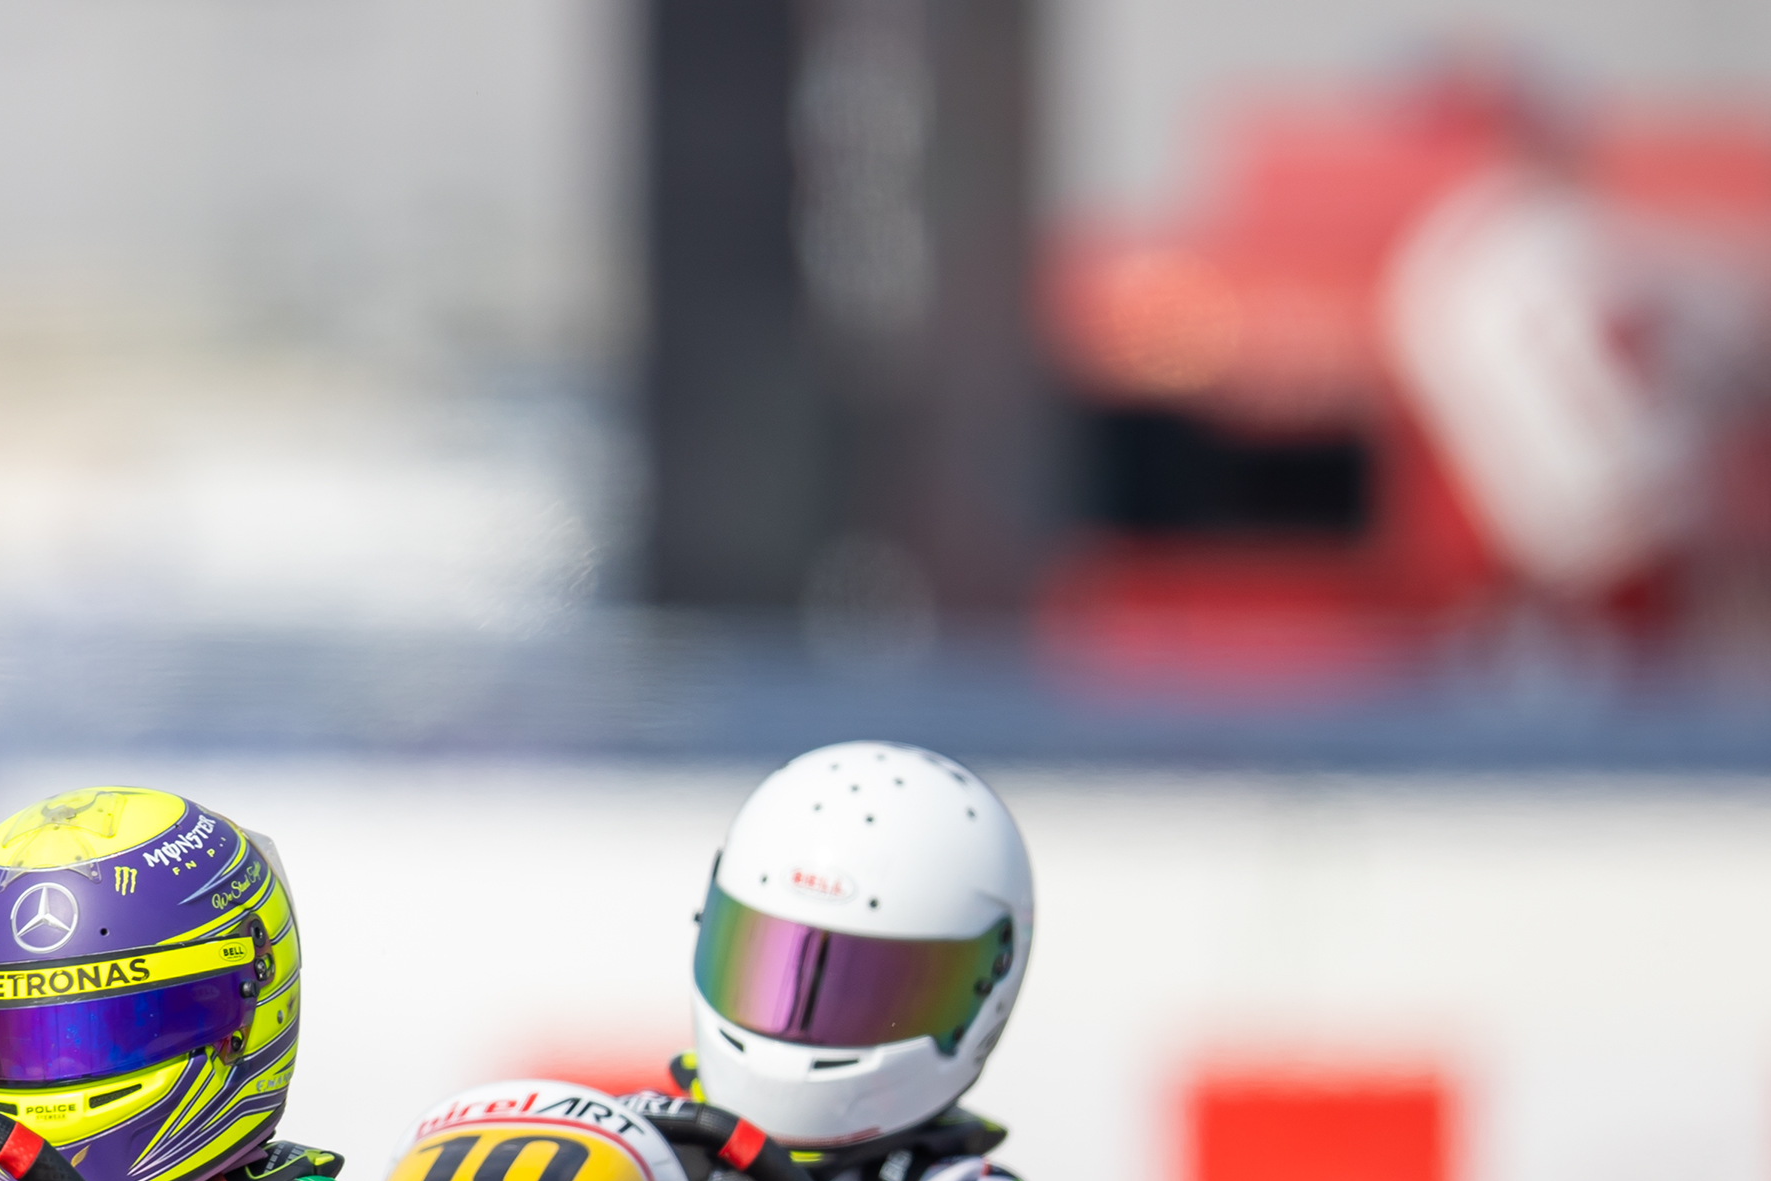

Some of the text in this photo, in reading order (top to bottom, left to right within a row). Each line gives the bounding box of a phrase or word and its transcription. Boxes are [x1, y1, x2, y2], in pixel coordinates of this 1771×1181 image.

[793, 871, 844, 896] BELL
[223, 946, 244, 957] BELL
[26, 1104, 76, 1114] POLICE
